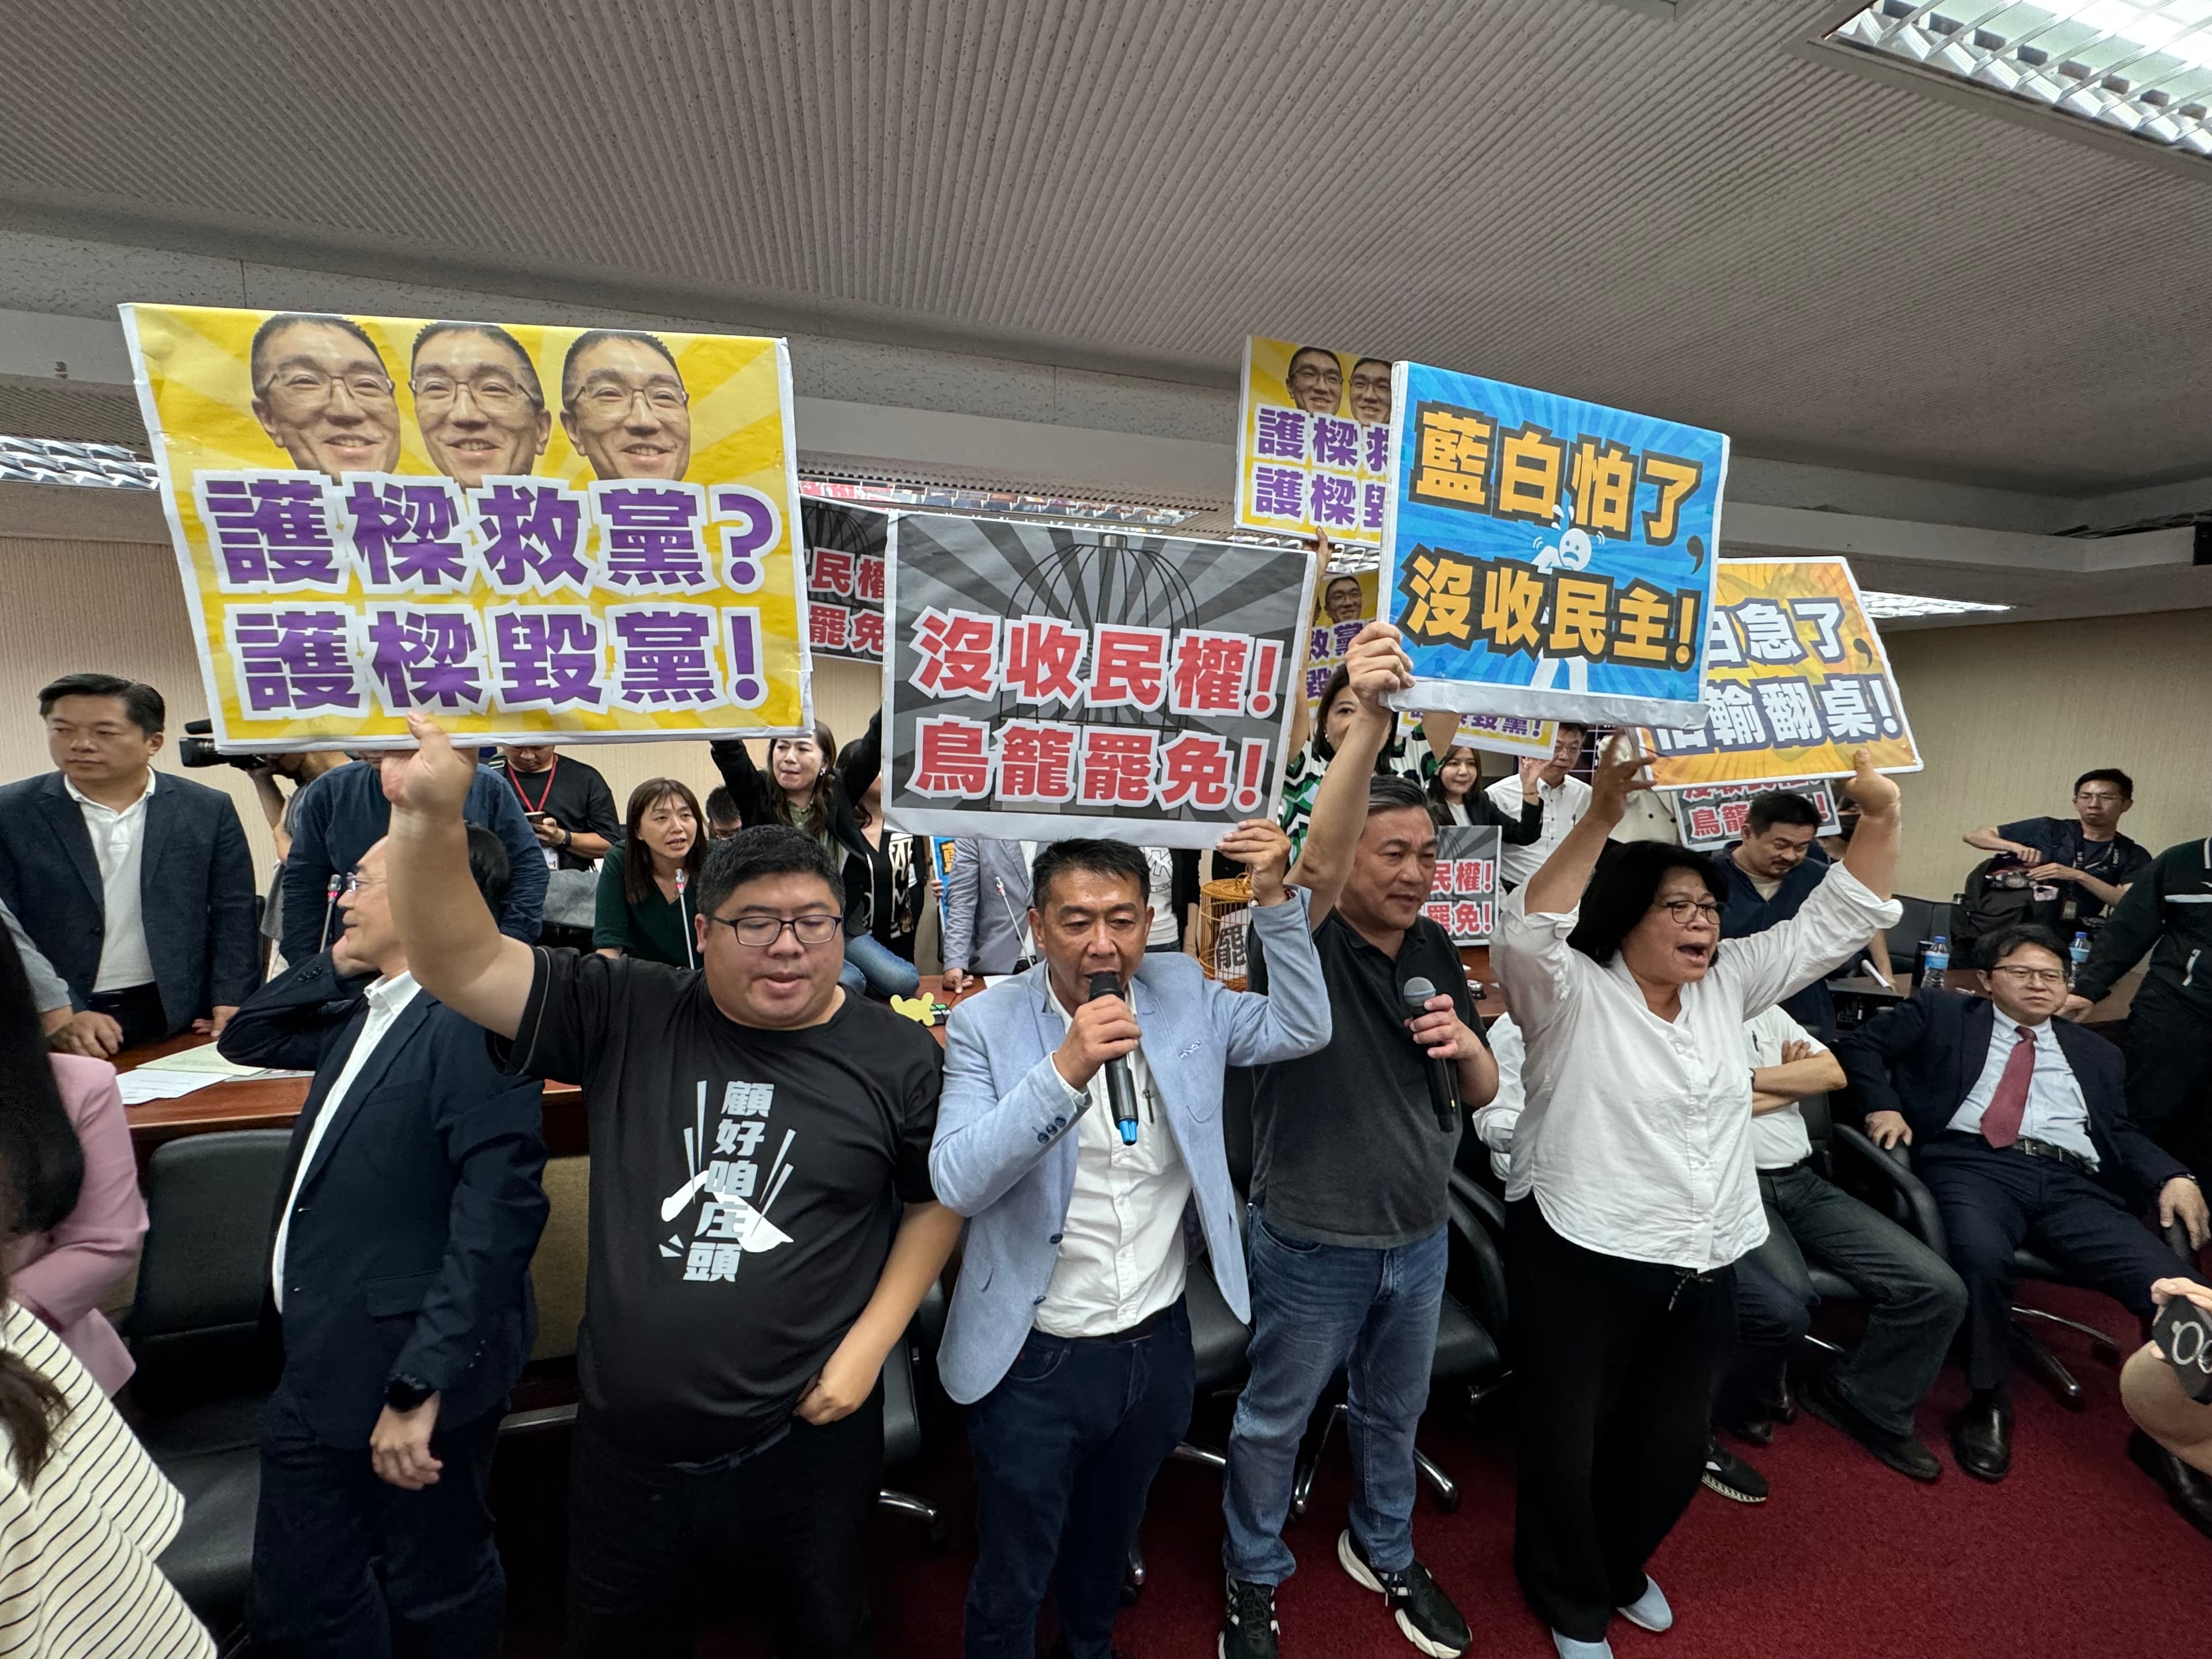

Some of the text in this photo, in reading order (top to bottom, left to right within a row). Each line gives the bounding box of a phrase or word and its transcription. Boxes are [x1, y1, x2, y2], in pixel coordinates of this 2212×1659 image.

[205, 479, 772, 585] 護樑救黨?
[1416, 412, 1703, 574] 藍白怕了,
[235, 611, 760, 711] 護樑毀黨!
[1407, 555, 1695, 664] 沒收民主!
[920, 614, 1277, 713] 沒收民權!
[915, 722, 1263, 806] 鳥籠罷免!
[683, 1081, 774, 1282] 顧好咱庄頭
